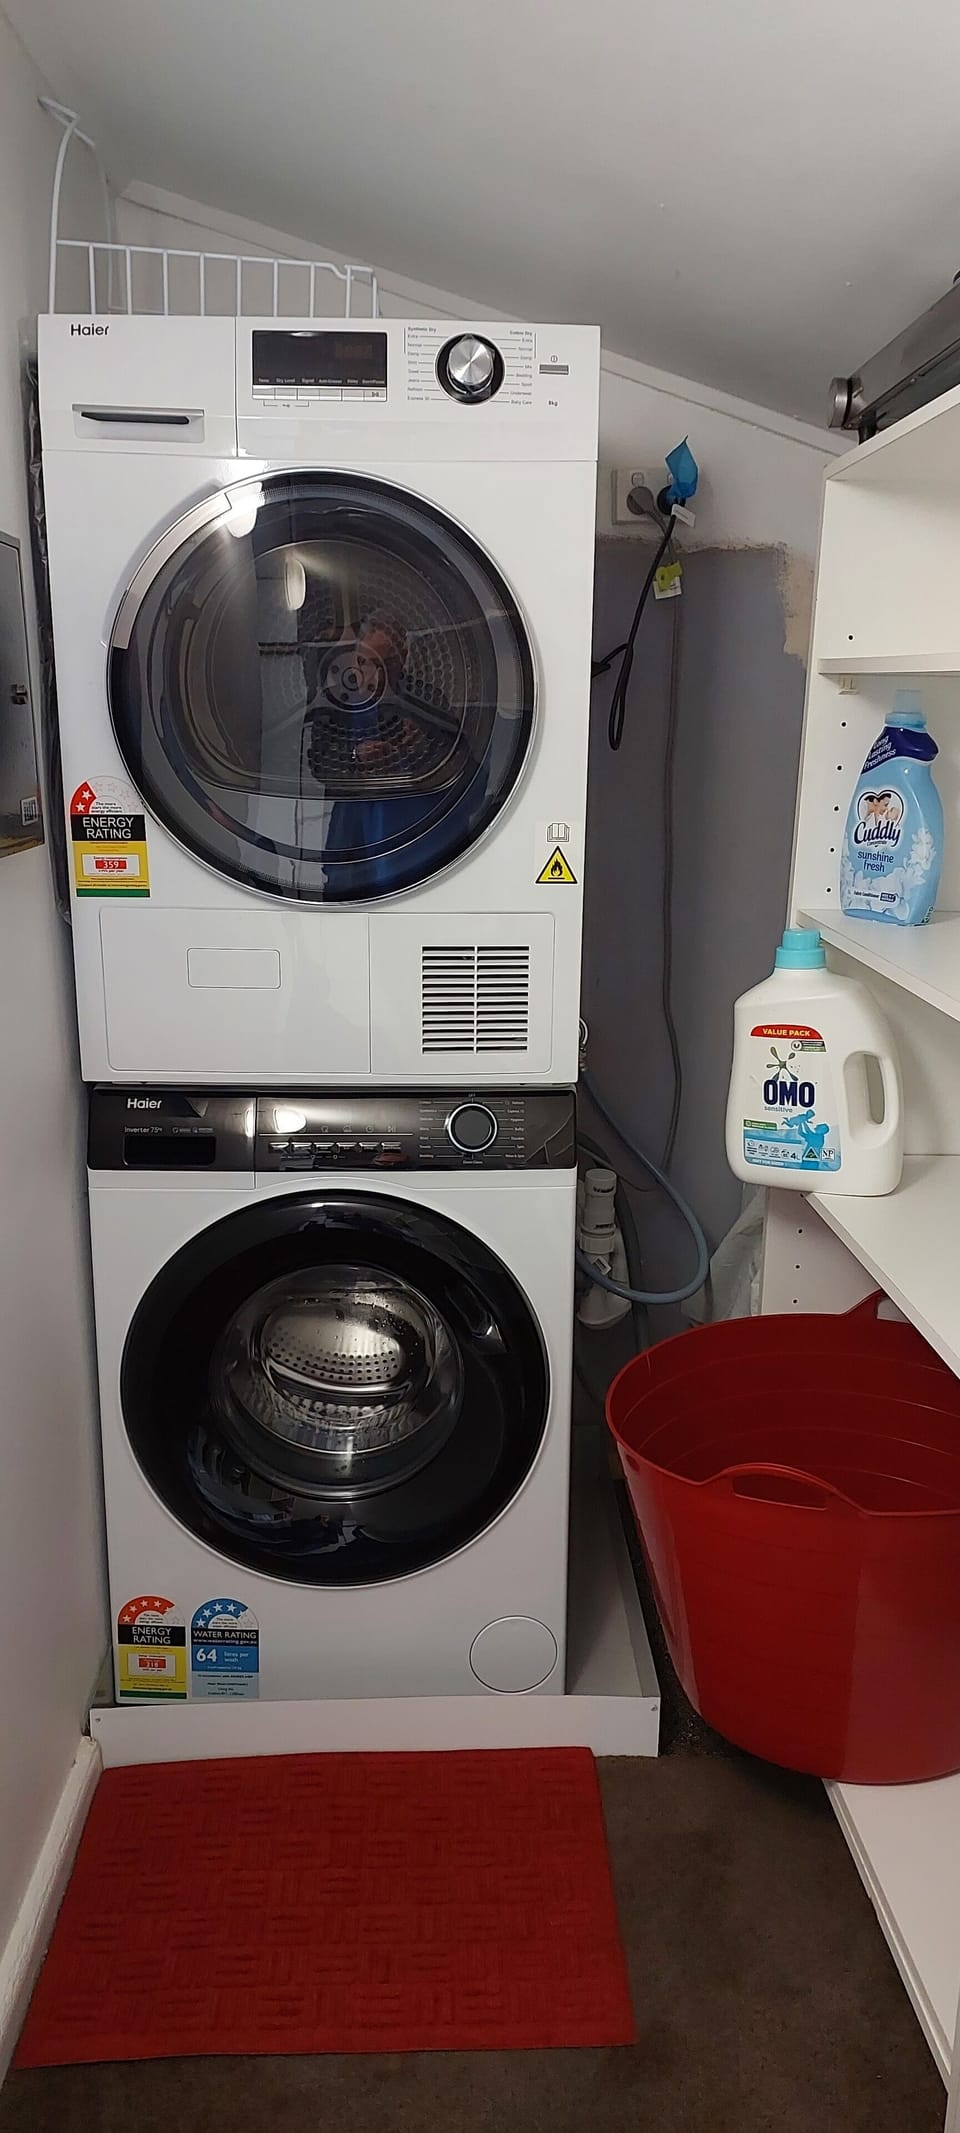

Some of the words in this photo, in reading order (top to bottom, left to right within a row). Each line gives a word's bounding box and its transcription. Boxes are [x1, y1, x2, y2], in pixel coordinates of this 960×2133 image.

[70, 323, 109, 336] Haier
[83, 817, 133, 827] ENERGY
[87, 828, 131, 838] RATING
[854, 820, 900, 847] Cuddly
[857, 851, 894, 863] sunshine
[103, 861, 119, 869] 359
[864, 860, 885, 872] fresh
[789, 1029, 811, 1037] PACK
[763, 1080, 815, 1107] OMO
[127, 1098, 162, 1109] Haier
[764, 1105, 793, 1113] sensitive
[132, 1626, 171, 1635] ENERGY
[193, 1630, 222, 1638] WATER
[225, 1631, 256, 1639] RATING
[134, 1636, 170, 1644] RATING
[196, 1648, 216, 1661] 64
